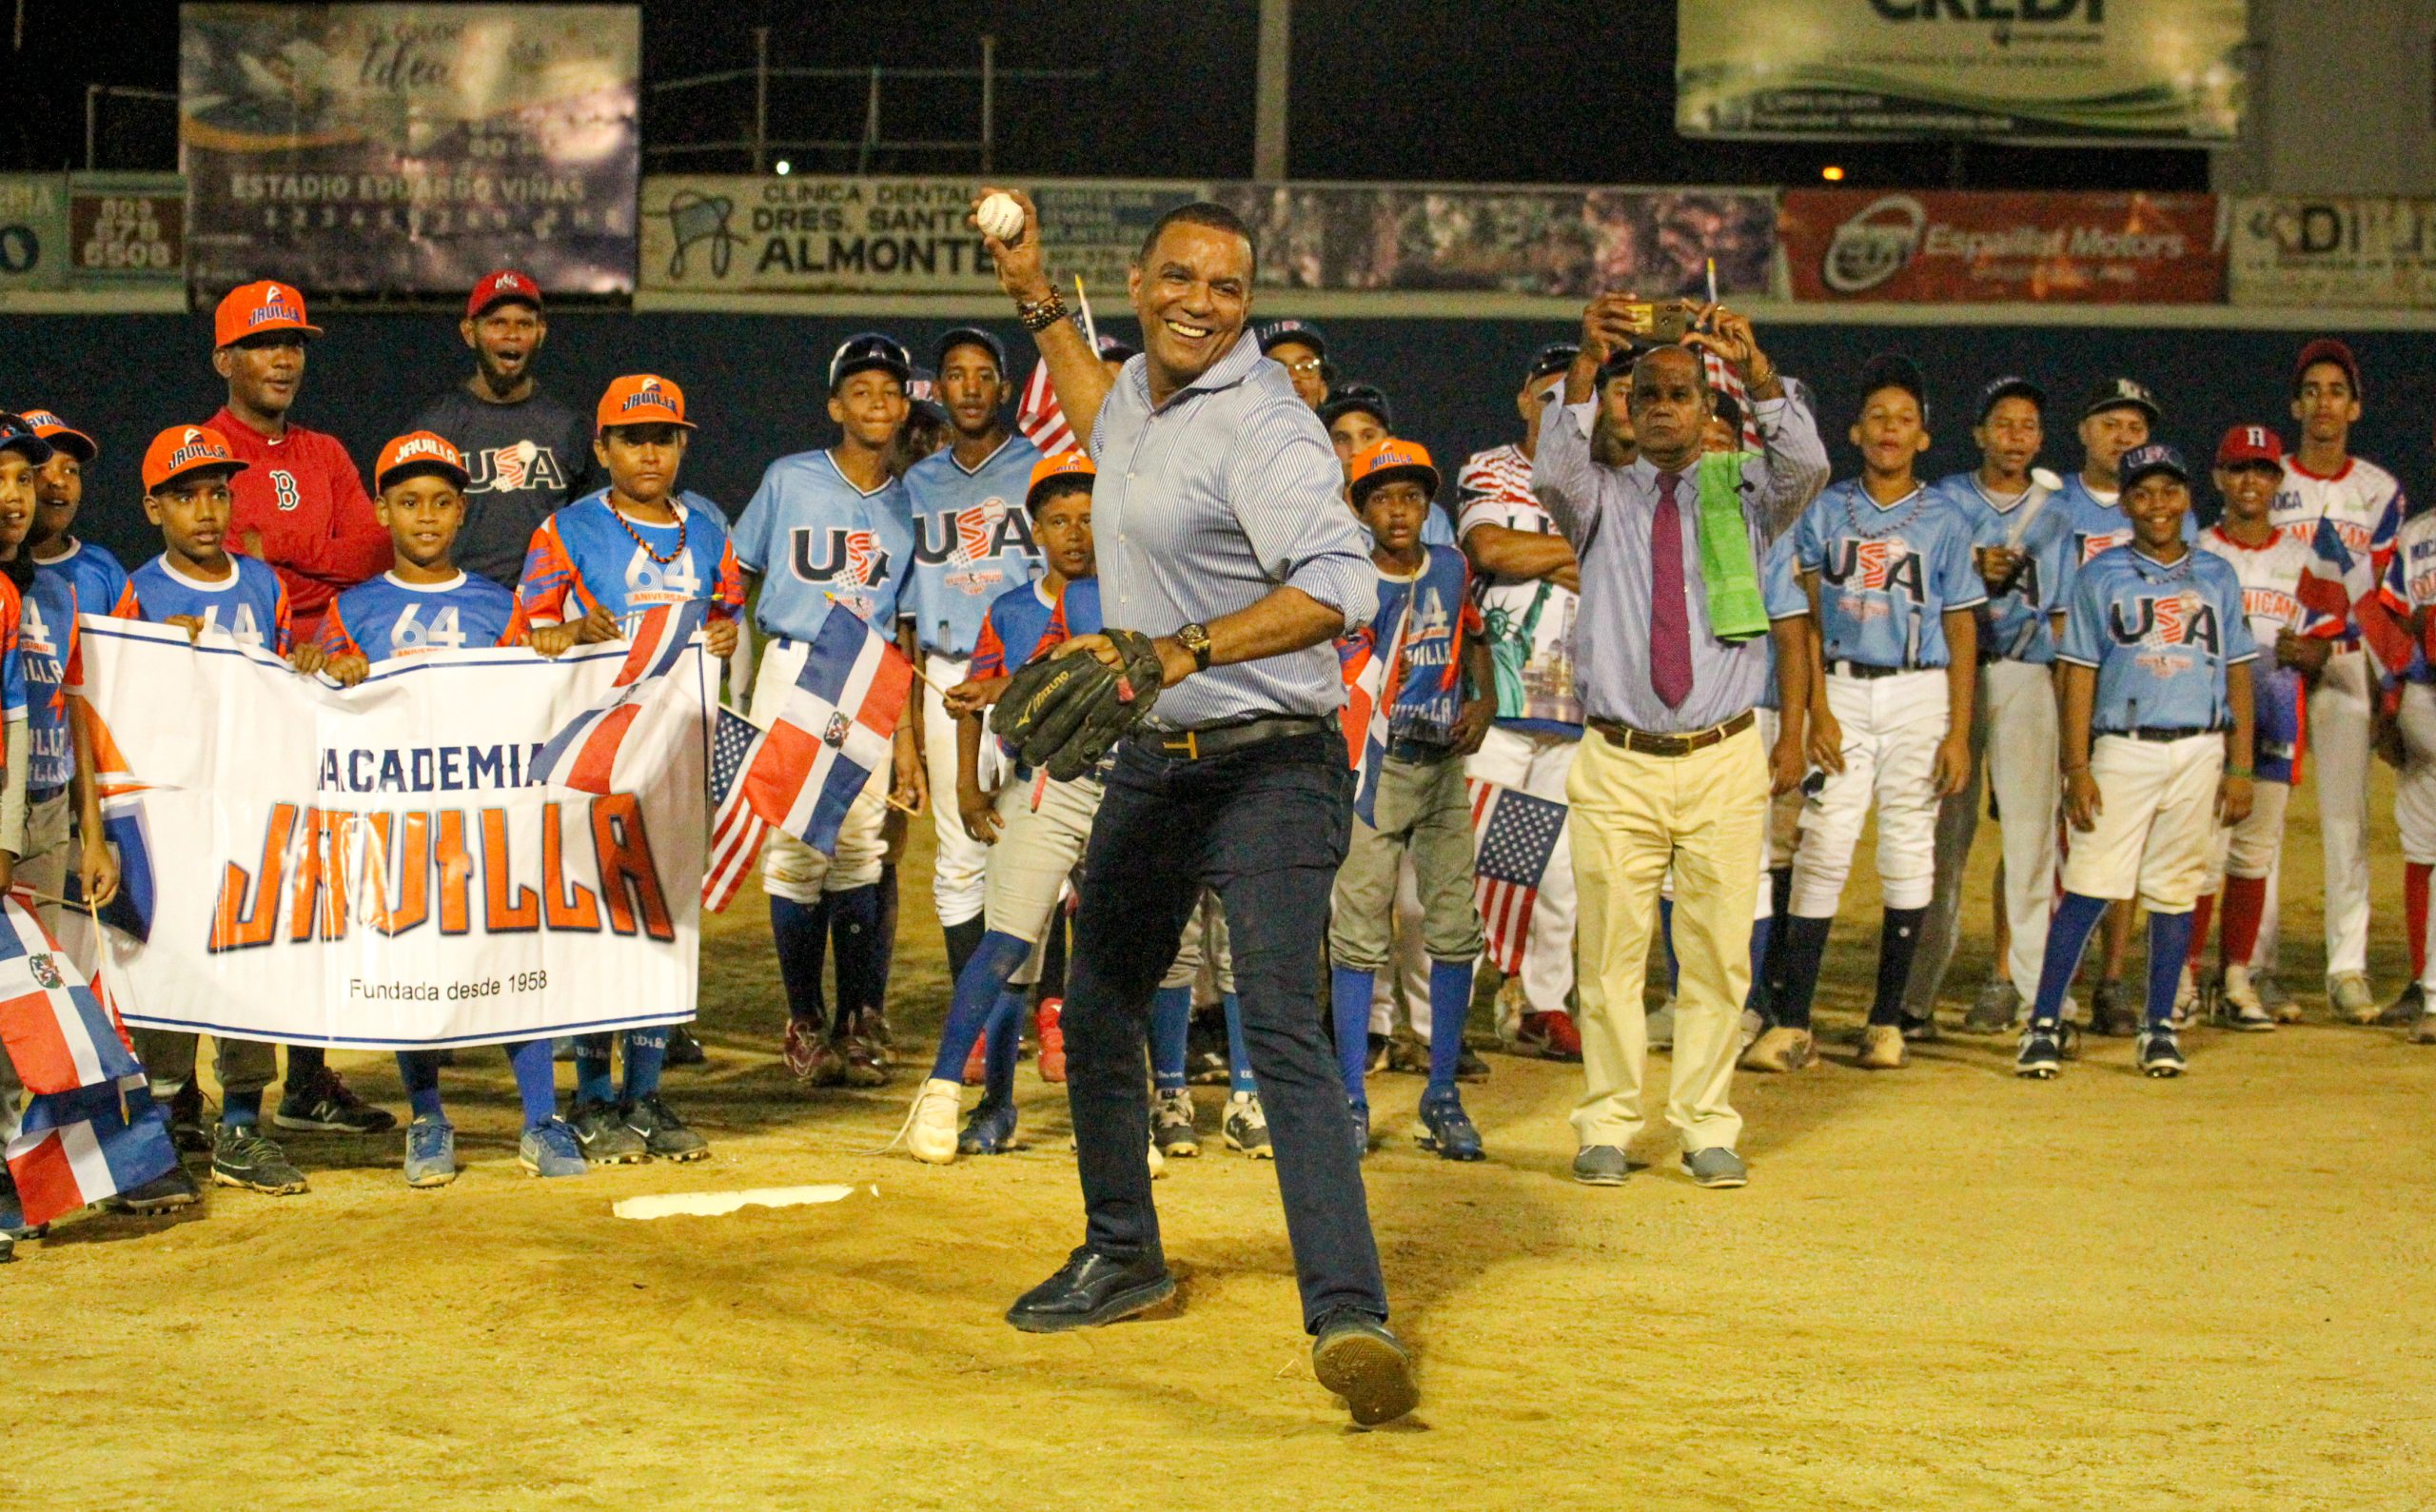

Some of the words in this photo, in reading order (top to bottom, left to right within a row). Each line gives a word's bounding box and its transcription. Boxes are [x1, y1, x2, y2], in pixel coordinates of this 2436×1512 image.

[230, 174, 349, 202] ESTADIO
[358, 174, 490, 202] EDUARDO
[763, 183, 861, 204] CLINICA
[753, 206, 853, 232] DRES.
[867, 206, 976, 233] SANT
[756, 238, 995, 275] ALMONTE
[2069, 226, 2184, 259] Motors
[168, 446, 228, 471] JAVILLA
[395, 439, 456, 464] JAVILLA
[463, 441, 568, 493] USA
[269, 469, 301, 511] B
[2271, 490, 2303, 511] OCA
[914, 498, 1044, 569] USA
[624, 542, 701, 592] 64
[790, 526, 891, 592] USA
[1822, 536, 1926, 607] USA
[390, 602, 466, 648] 64
[2110, 592, 2220, 657] USA
[207, 792, 677, 953] JAVILLA
[349, 978, 440, 1001] Fundada
[446, 977, 501, 1000] desde
[508, 970, 548, 993] 1958
